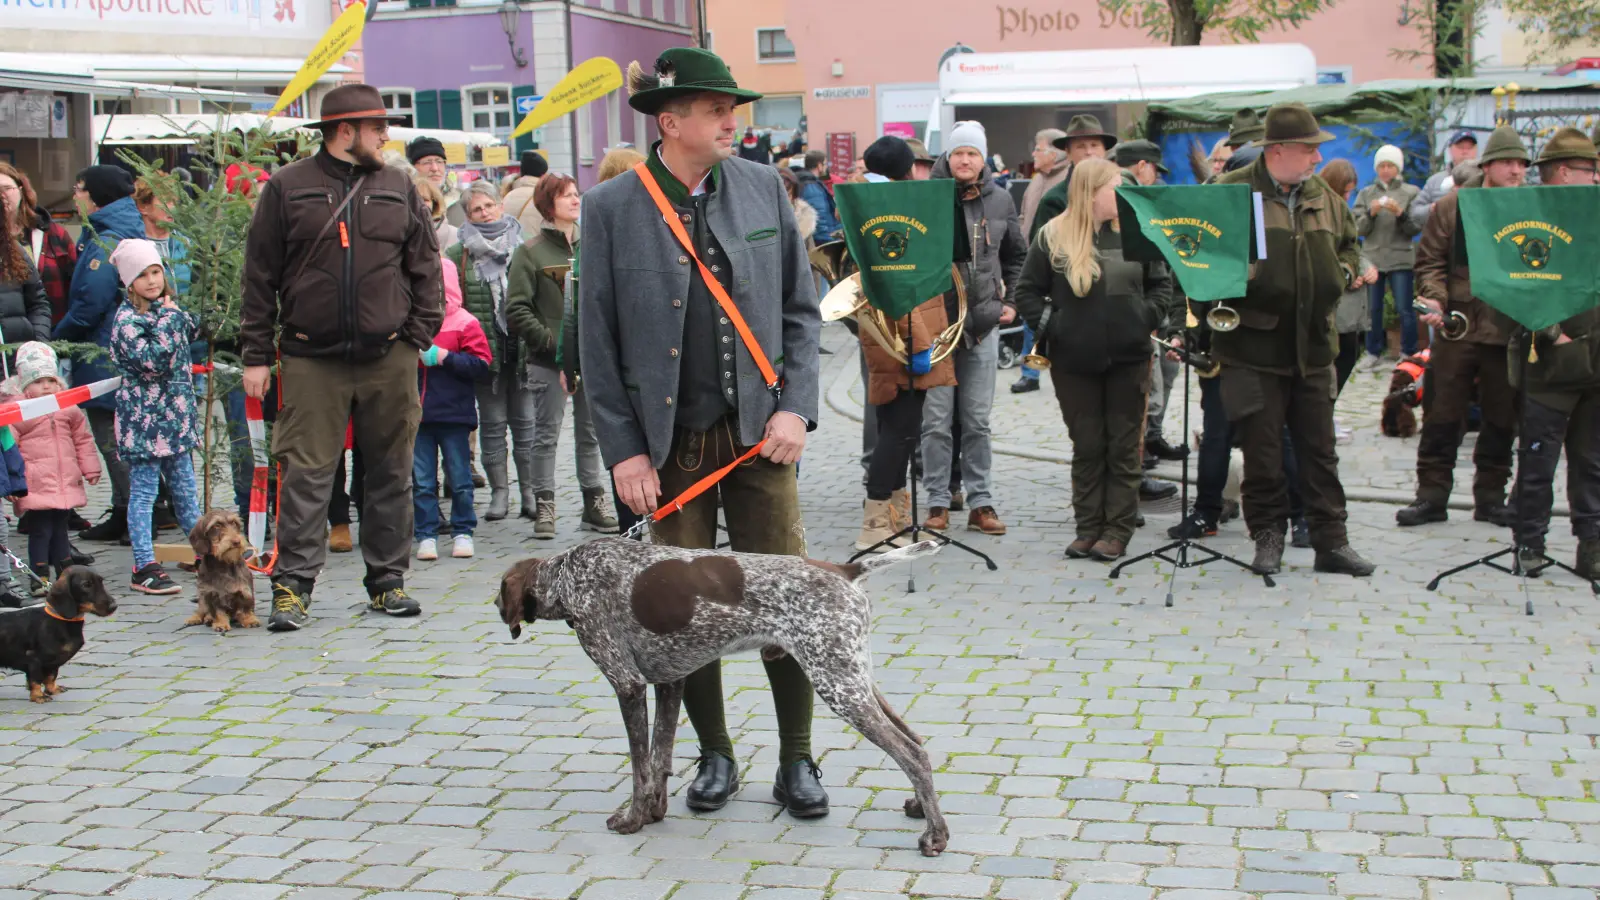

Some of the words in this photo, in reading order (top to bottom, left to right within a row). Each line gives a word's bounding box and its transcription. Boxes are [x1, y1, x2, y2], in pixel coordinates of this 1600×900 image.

[996, 5, 1080, 40] Photo
[860, 214, 928, 236] JAGDHORNBLÄSER
[1150, 217, 1222, 239] JDHORNBLÄSER
[1493, 220, 1573, 245] JAGDHORNBLÄSER
